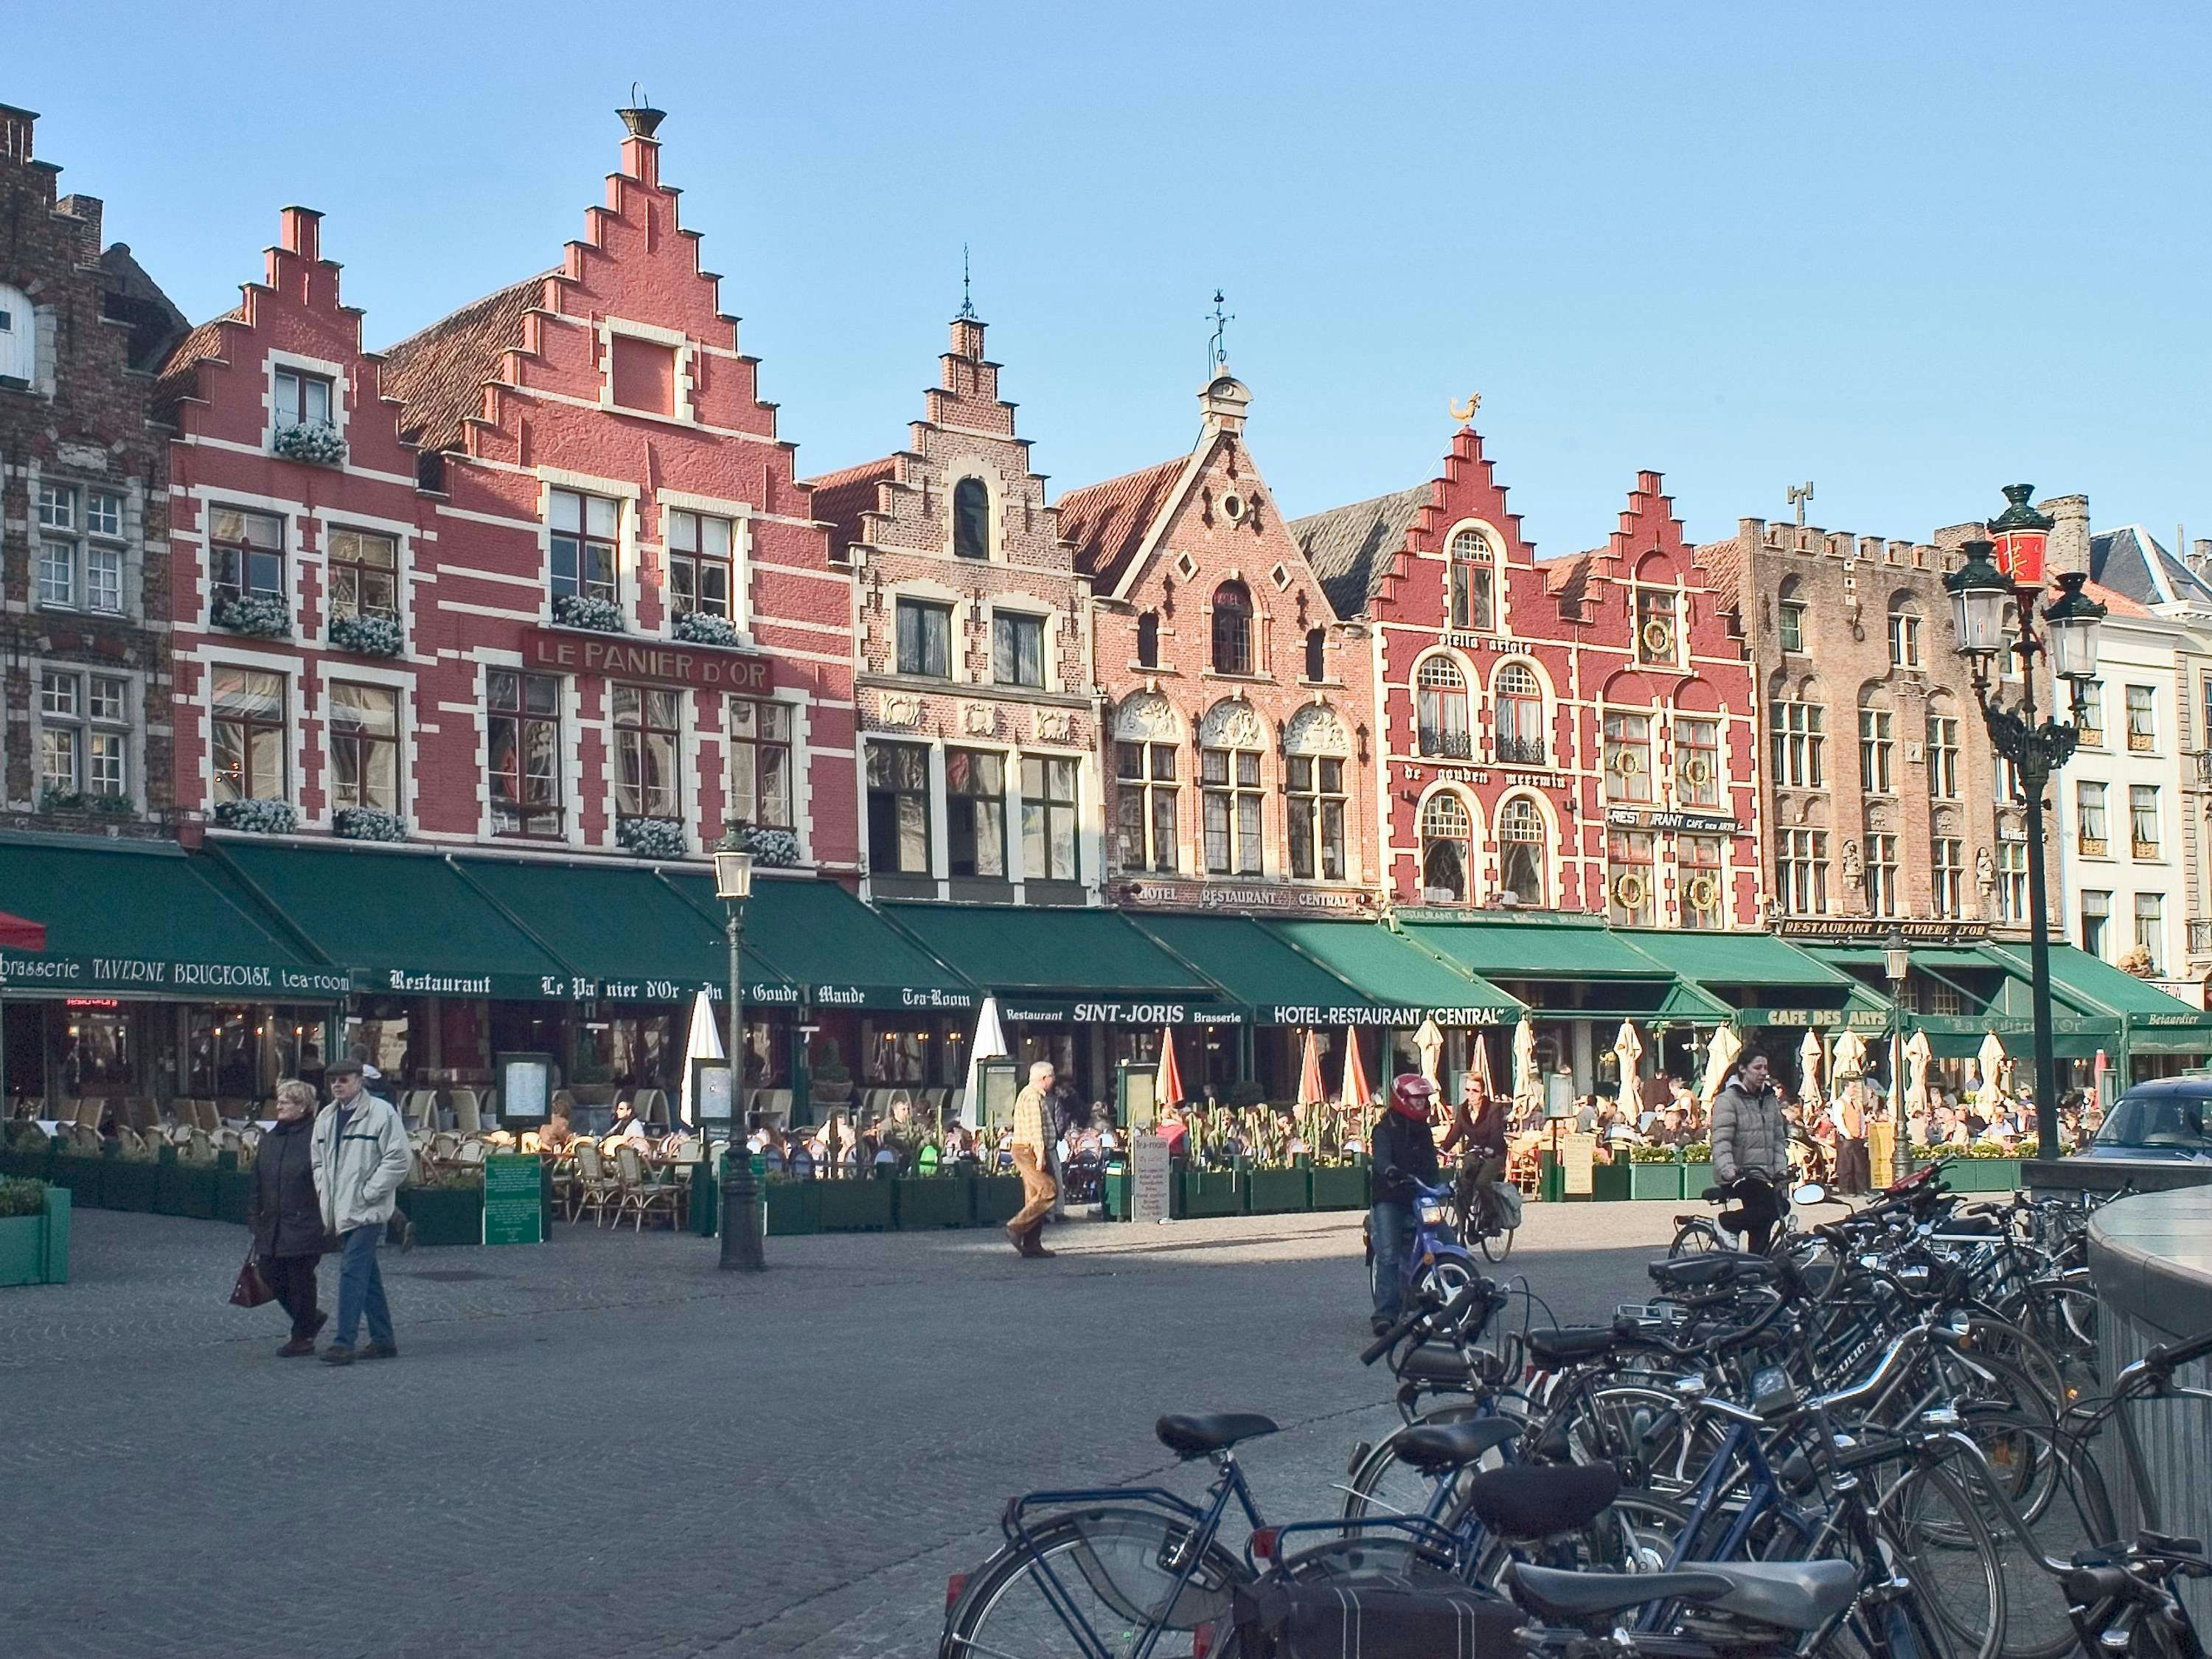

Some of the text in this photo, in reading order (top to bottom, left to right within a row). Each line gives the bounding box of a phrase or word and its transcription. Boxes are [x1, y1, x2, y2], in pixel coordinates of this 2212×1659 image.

[1439, 633, 1531, 654] stella artois
[538, 641, 766, 688] LE PANIER D'OR
[1404, 764, 1565, 788] de gouden meermin
[1610, 810, 1684, 827] RESTRANT
[1139, 886, 1349, 907] HOTEL RESTAURANT CENTRAL
[1784, 922, 1873, 933] RESTAURANT
[0, 953, 349, 990] brasserie TAVERNE BRUGEOISE tea-room
[389, 970, 490, 993] Restaurant
[541, 975, 564, 995] Le
[646, 981, 680, 998] d'Or
[753, 984, 799, 1001] Goude
[818, 984, 865, 1004] Mande
[902, 987, 970, 1006] Tea-Room
[1006, 1003, 1241, 1023] Restaurant SINT-JORIS Brasserie
[1274, 1006, 1421, 1026] HOTEL-RESTAURANT
[1767, 1010, 1886, 1026] CAFE DES ARTS
